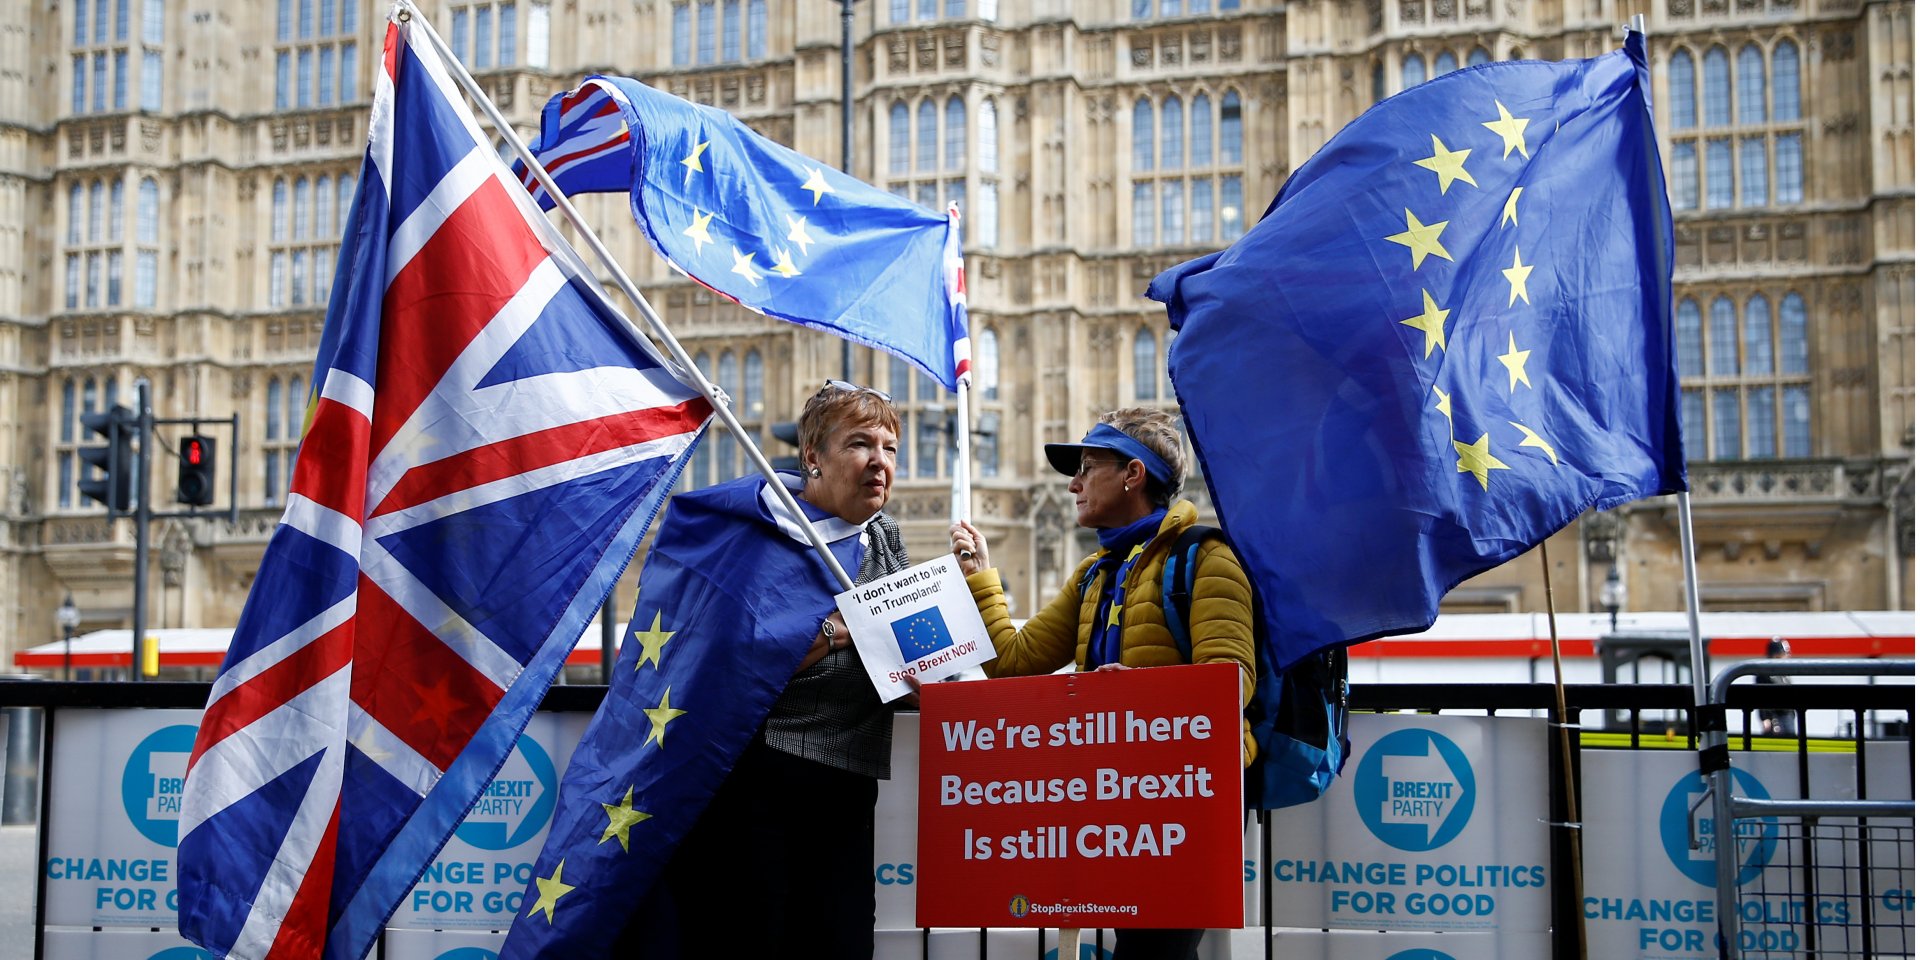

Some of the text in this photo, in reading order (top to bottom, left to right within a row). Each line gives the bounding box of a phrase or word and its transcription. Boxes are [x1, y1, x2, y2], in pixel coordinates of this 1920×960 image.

[863, 581, 893, 602] don't
[894, 574, 919, 590] want
[919, 569, 931, 581] to
[931, 563, 948, 577] live
[869, 580, 942, 616] in Trumpland!'
[889, 639, 978, 683] Stop Brexit NOW!
[941, 710, 1212, 752] We're still here
[484, 780, 534, 797] REXIT
[940, 764, 1215, 806] Because Brexit
[1393, 781, 1453, 799] BREXIT
[472, 798, 523, 815] PARTY
[1393, 800, 1443, 817] PARTY
[964, 823, 1186, 860] Is still CRAP
[47, 857, 168, 882] CHANGE
[1274, 859, 1406, 886] CHANGE
[1416, 864, 1545, 888] POLITICS
[96, 887, 157, 911] FOR
[413, 890, 474, 913] FOR
[1030, 902, 1138, 916] StopBrexitSteve.org
[1332, 890, 1495, 916] FOR GOOD
[1583, 896, 1714, 923] CHANGE
[1640, 928, 1704, 952] FOR
